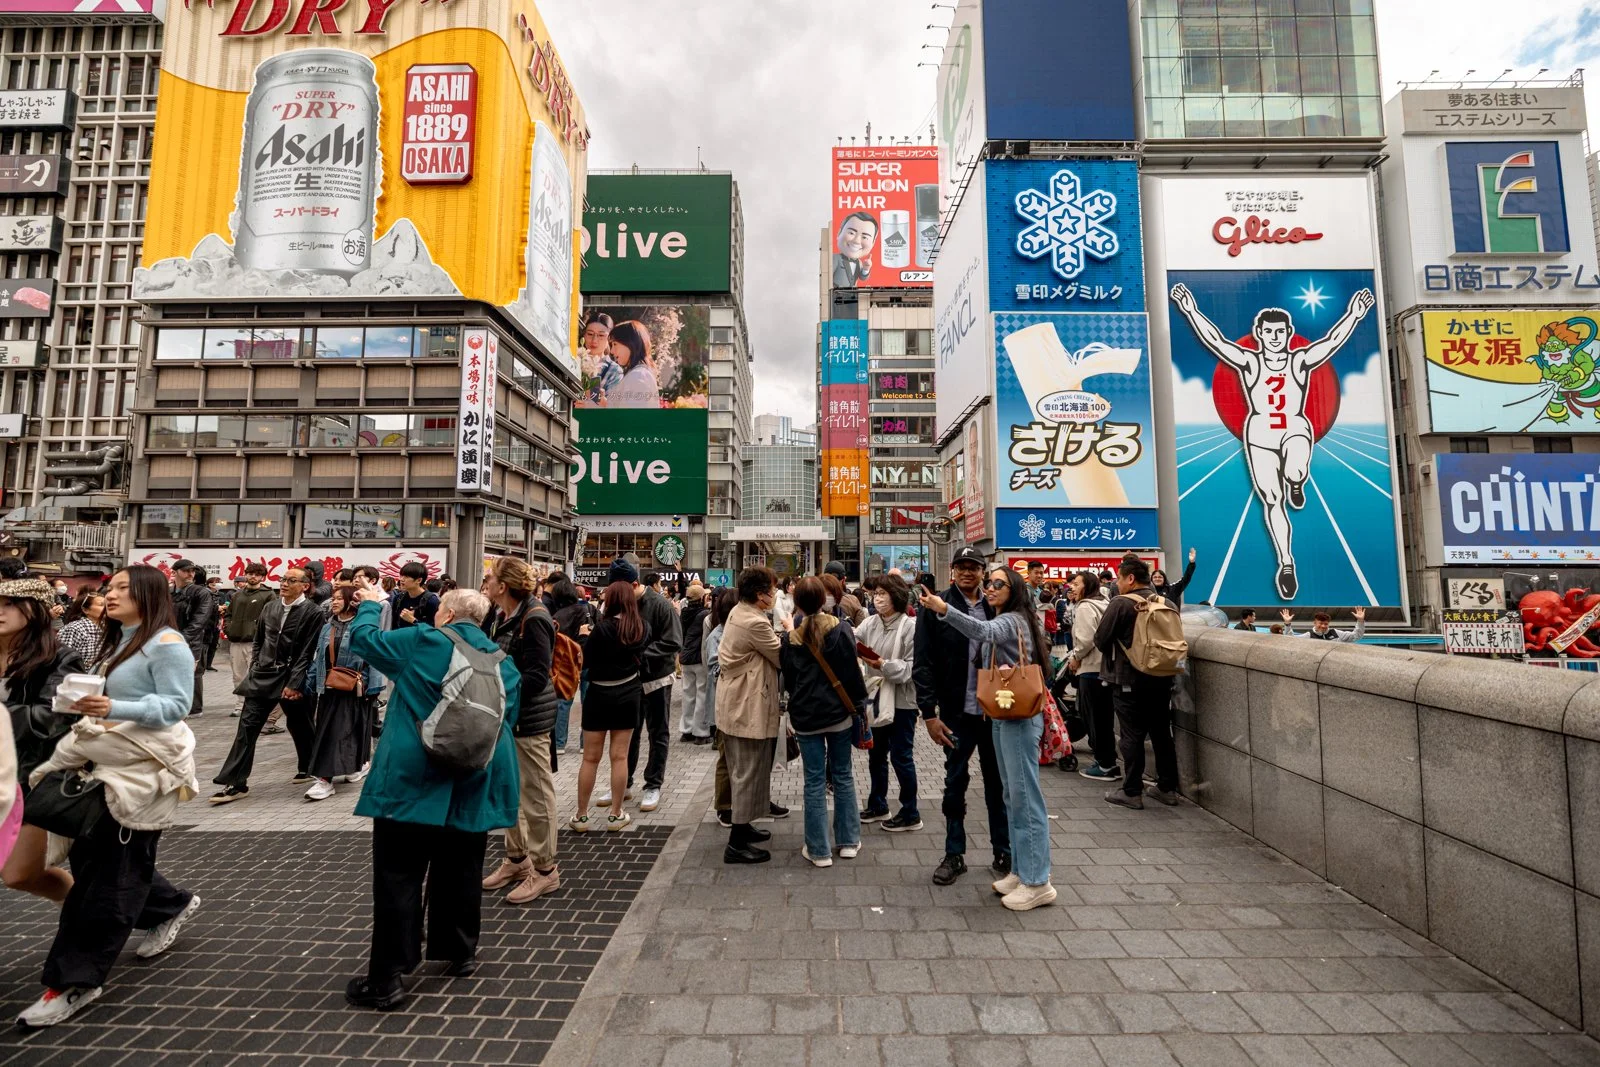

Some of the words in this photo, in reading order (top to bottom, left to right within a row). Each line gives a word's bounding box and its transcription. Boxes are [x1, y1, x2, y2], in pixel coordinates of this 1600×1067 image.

[295, 90, 336, 99] SUPER
[407, 75, 470, 102] ASAHI
[0, 96, 56, 107] しゃぶしゃぶ
[424, 102, 453, 114] since
[1448, 93, 1538, 108] 夢ある住まい
[0, 108, 41, 120] すき焼き
[1435, 112, 1557, 127] エステムシリーズ
[406, 113, 468, 142] 1889
[254, 123, 365, 170] Asahi
[404, 146, 465, 174] OSAKA
[838, 162, 902, 176] SUPER
[294, 172, 322, 191] 生
[838, 179, 909, 193] MILLION
[838, 195, 887, 209] HAIR
[273, 206, 340, 218] スーパードライ
[1424, 262, 1600, 291] 日商エステム
[1015, 282, 1123, 300] 雪印メグミルク
[940, 292, 976, 370] FANCL
[1446, 318, 1514, 336] かぜに
[1440, 338, 1524, 366] 改源
[466, 353, 481, 405] 本場の味
[829, 400, 860, 414] 龍角散
[1265, 373, 1287, 430] グリコ
[460, 410, 480, 484] かに道楽
[1009, 421, 1141, 467] さける
[829, 466, 861, 480] 龍角散
[1009, 468, 1062, 491] チーズ
[1051, 526, 1137, 541] 雪印メグミルク
[1451, 551, 1479, 560] 天気予報
[1459, 582, 1495, 605] くくる
[1449, 628, 1513, 648] 大阪に乾杯
